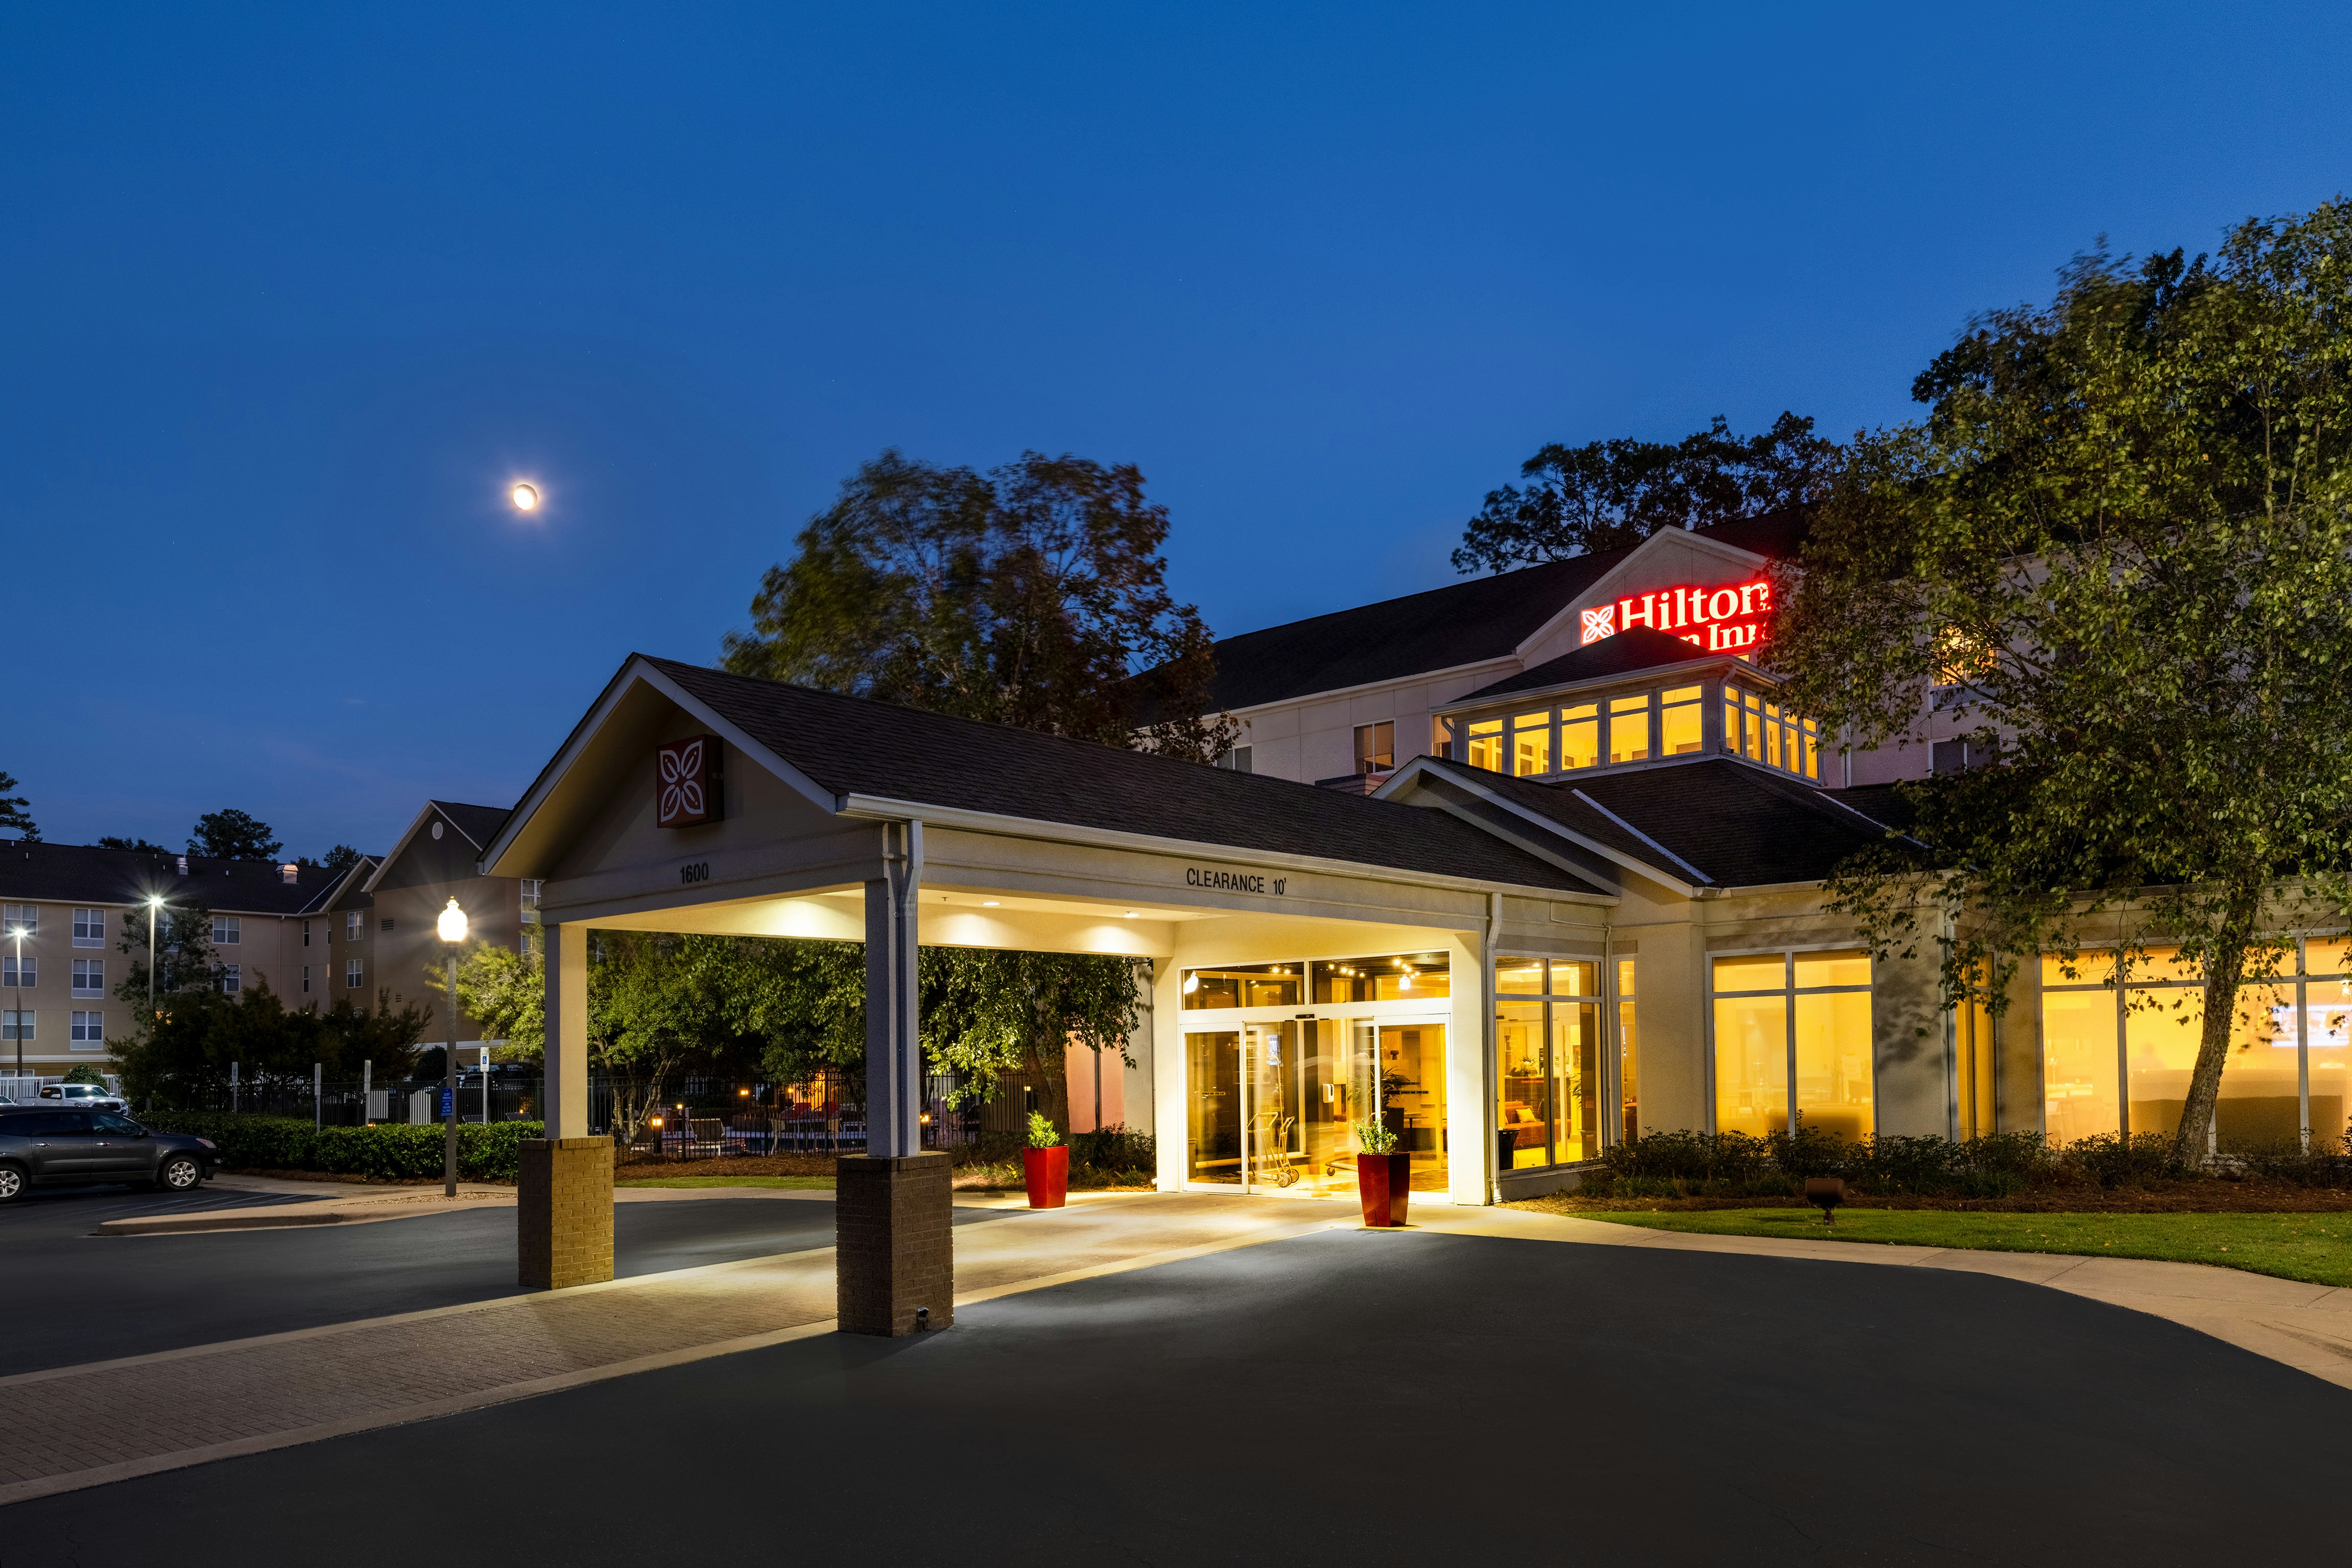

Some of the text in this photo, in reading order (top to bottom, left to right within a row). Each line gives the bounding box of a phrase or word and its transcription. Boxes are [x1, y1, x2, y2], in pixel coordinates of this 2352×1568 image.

[1619, 582, 1771, 631] Hilton
[680, 862, 709, 884] 1600
[1186, 868, 1264, 894] CLEARANCE
